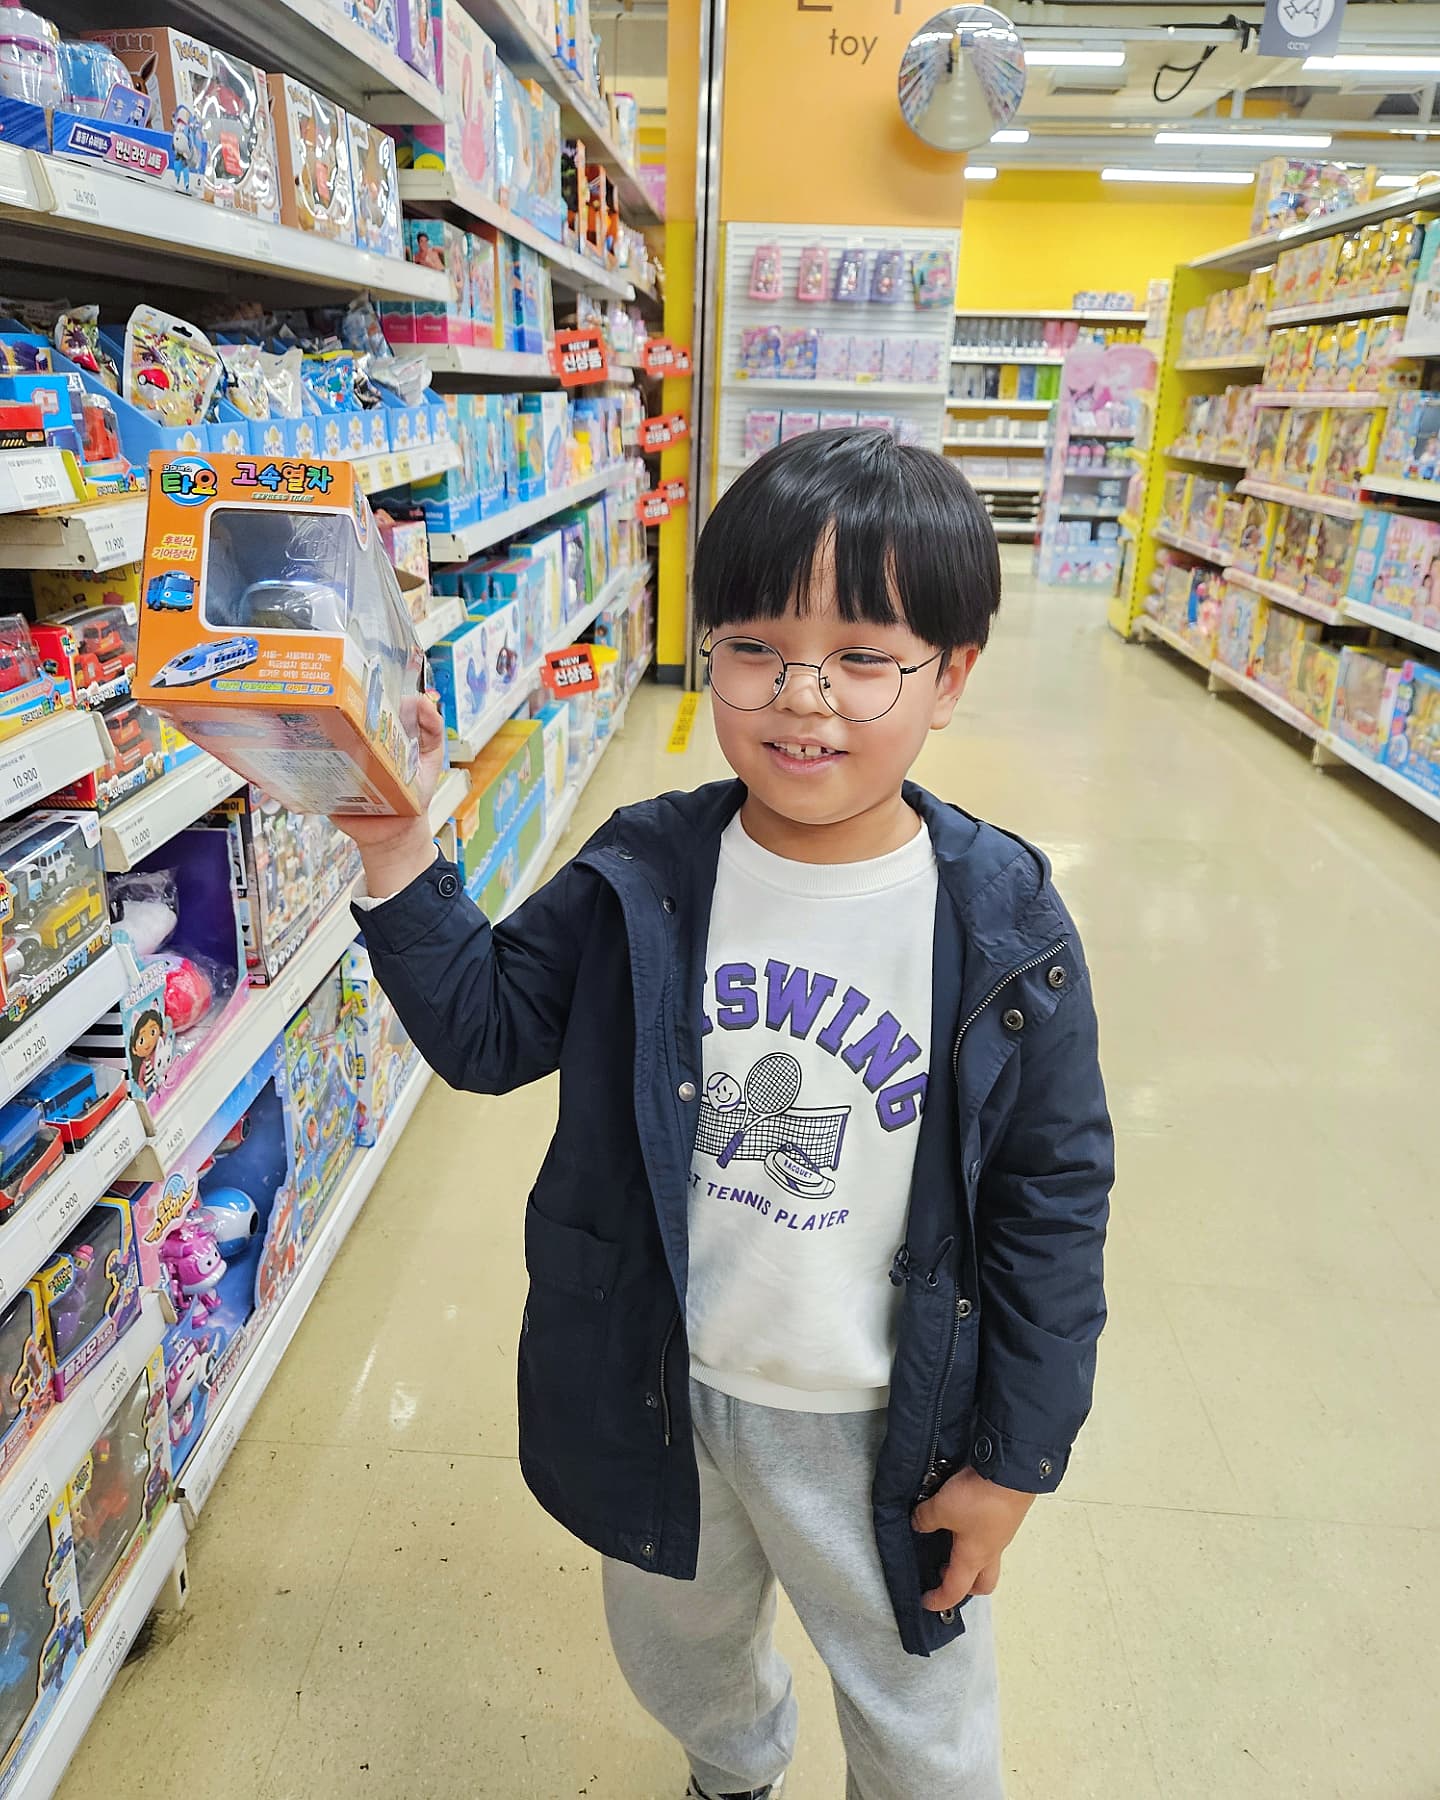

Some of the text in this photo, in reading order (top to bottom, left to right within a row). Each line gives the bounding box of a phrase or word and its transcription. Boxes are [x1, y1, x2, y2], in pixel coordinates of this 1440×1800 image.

[829, 28, 878, 65] toy
[568, 341, 590, 351] NEW
[161, 469, 217, 495] 타요
[232, 462, 333, 492] 고속열차
[163, 535, 193, 546] 후릭션
[559, 656, 580, 666] NEW
[702, 958, 929, 1132] SWING
[784, 1159, 813, 1178] RACQUET
[707, 1182, 771, 1215] TENNIS
[774, 1209, 849, 1231] PLAYER
